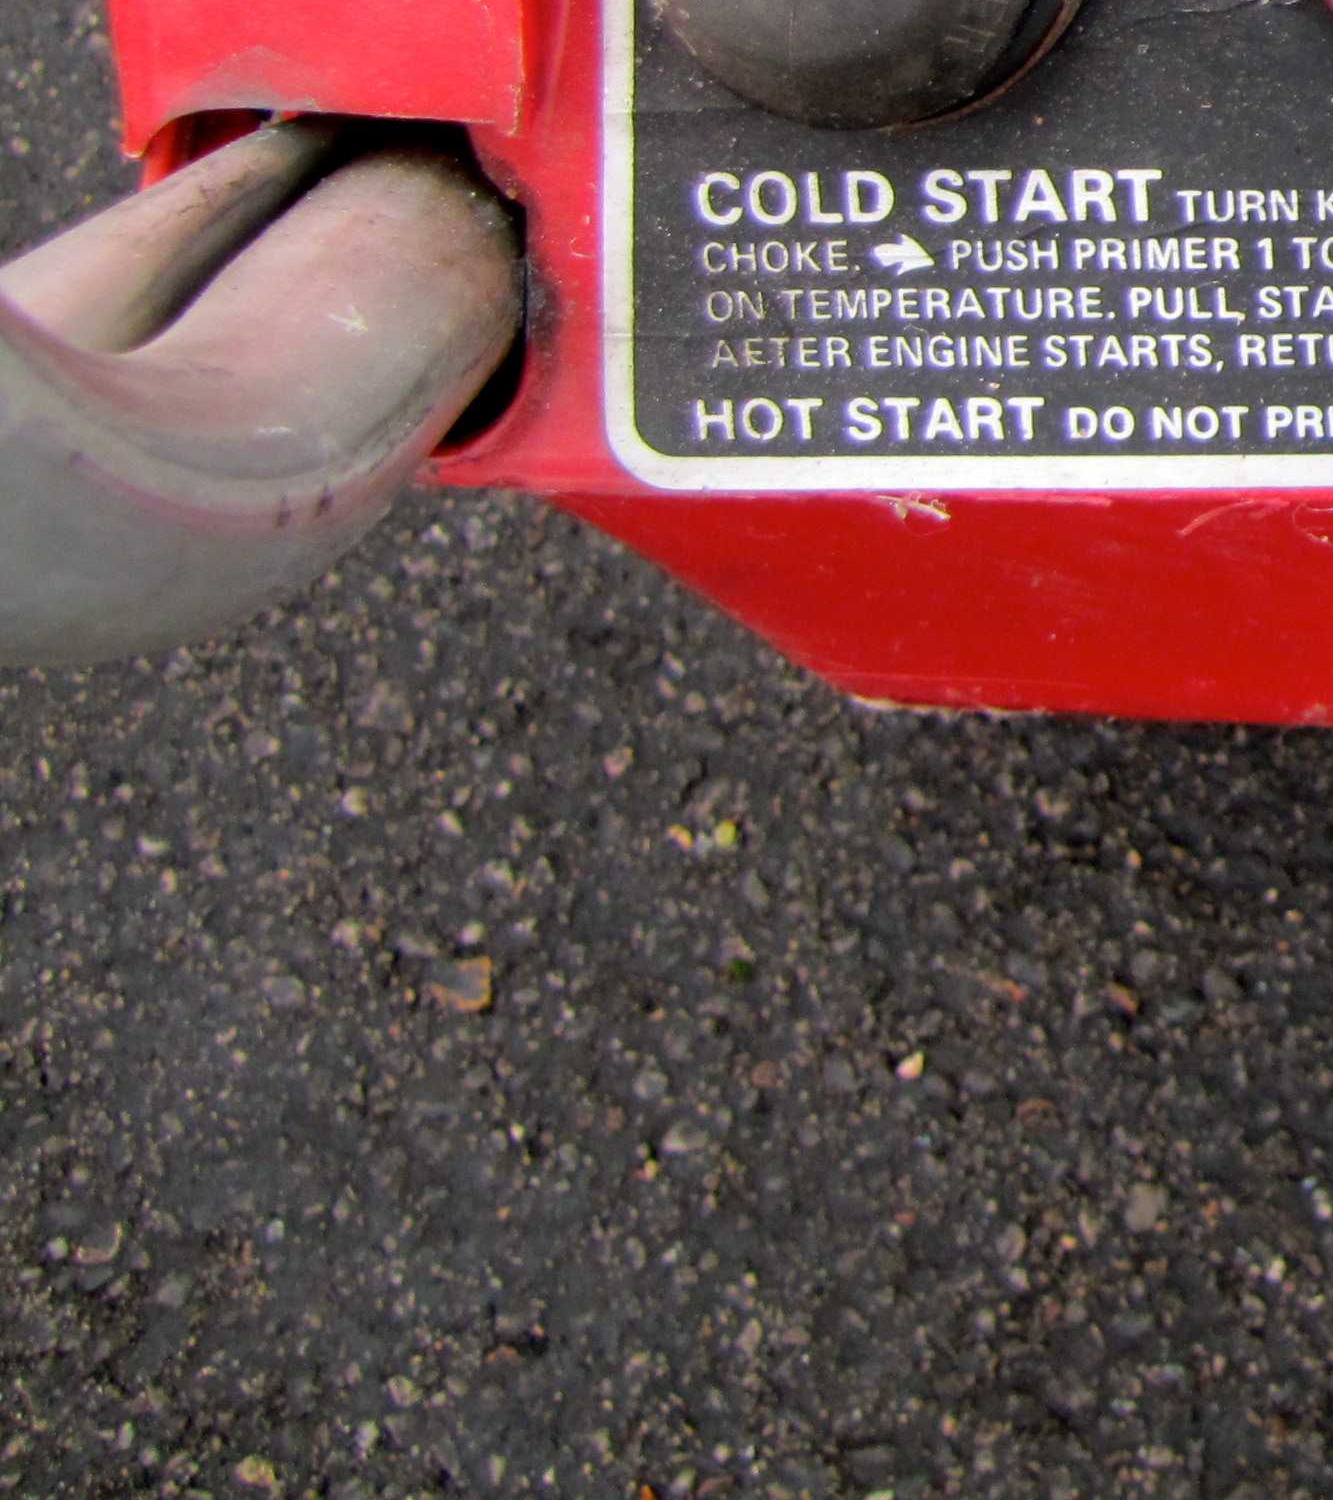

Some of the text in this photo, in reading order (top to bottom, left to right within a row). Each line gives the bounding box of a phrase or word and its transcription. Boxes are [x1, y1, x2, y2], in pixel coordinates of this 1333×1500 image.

[694, 170, 894, 227] COLD
[923, 168, 1163, 224] START
[1176, 189, 1299, 223] TURN
[701, 239, 861, 273] CHOKE.
[950, 239, 1059, 272] PUSH
[1073, 237, 1241, 271] PRIMER
[1257, 237, 1274, 270] 1
[705, 290, 765, 323] ON
[780, 286, 1116, 321] TEMPERATURE.
[1128, 286, 1246, 320] PULL
[868, 335, 1030, 368] ENGINE
[1043, 333, 1224, 373] STARTS,
[694, 397, 823, 441] HOT
[846, 396, 1045, 442] START
[1067, 406, 1135, 441] DO
[1151, 405, 1249, 441] NOT
